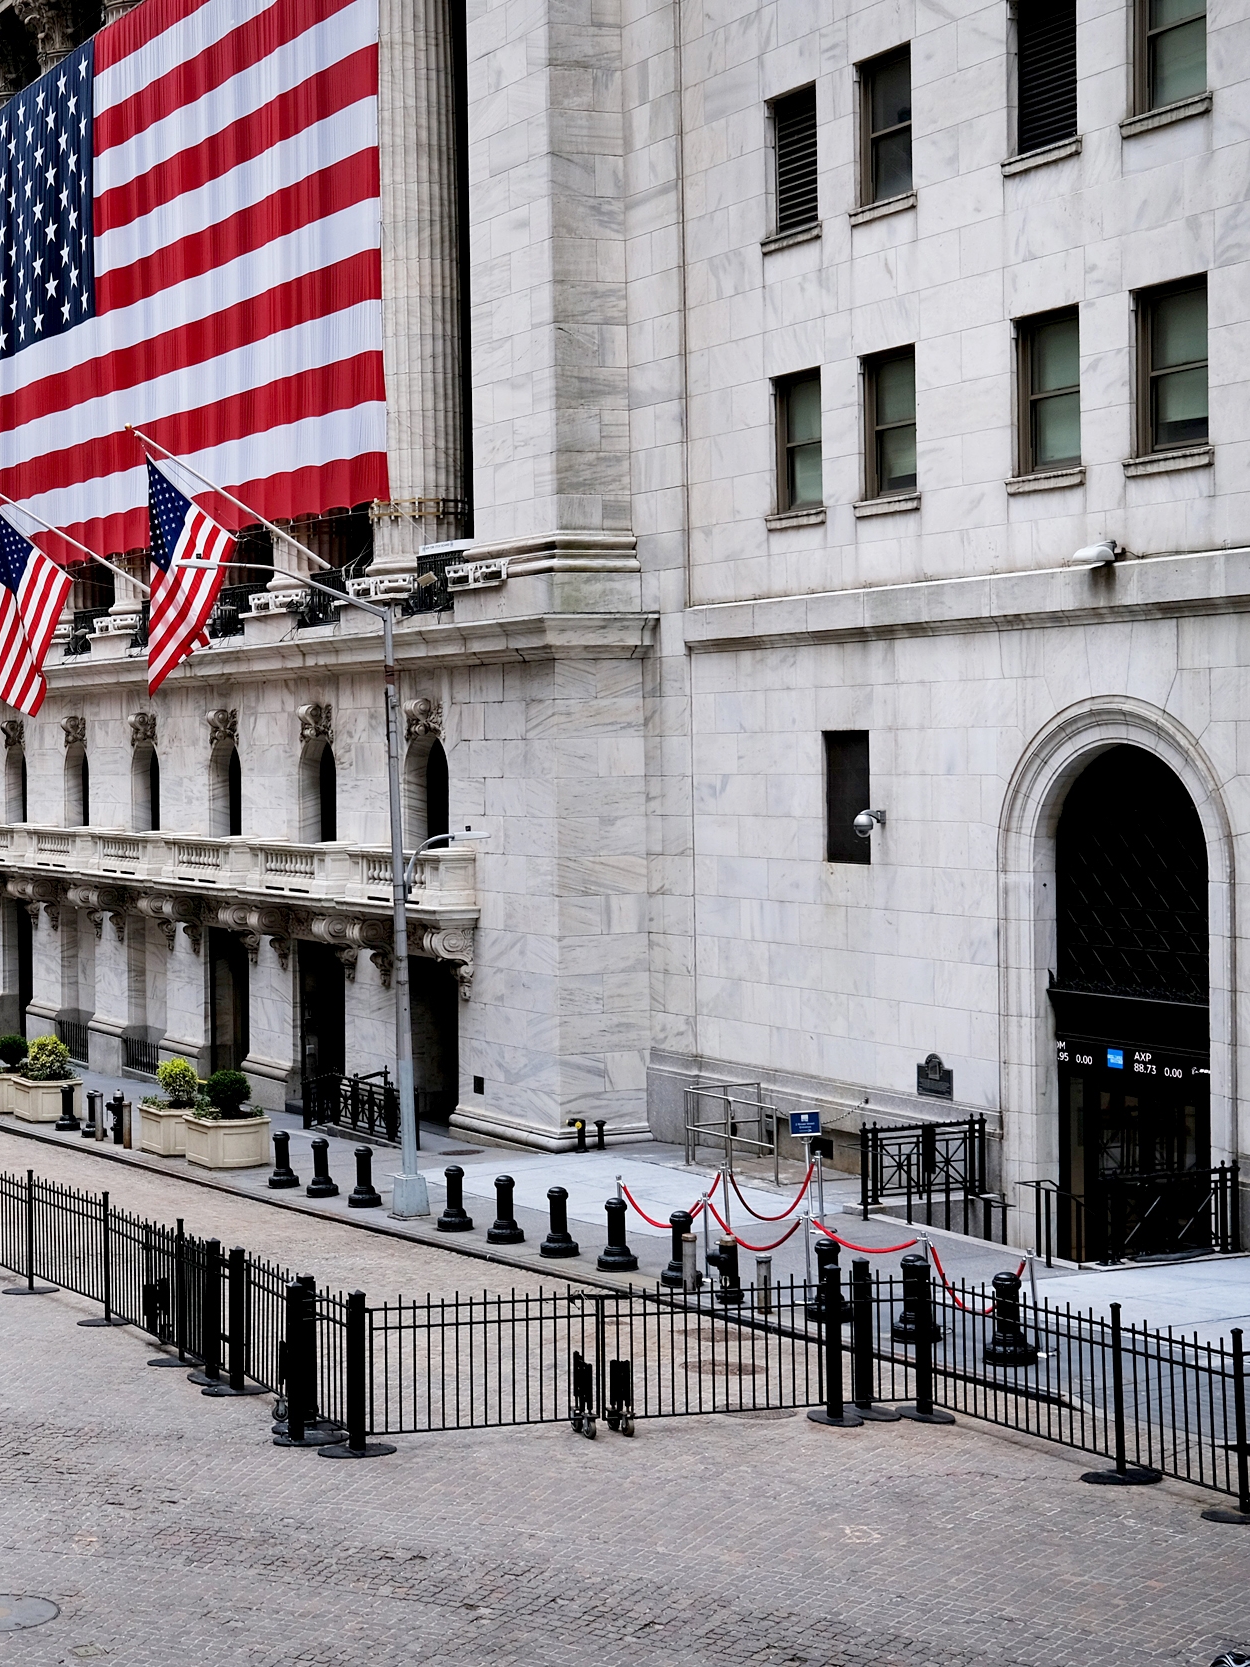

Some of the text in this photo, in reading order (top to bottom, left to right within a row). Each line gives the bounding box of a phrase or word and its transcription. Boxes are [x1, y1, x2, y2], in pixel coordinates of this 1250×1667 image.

[1075, 1053, 1093, 1066] 0.00
[1133, 1051, 1152, 1063] AXP
[1133, 1062, 1157, 1075] 88.73
[1164, 1066, 1183, 1079] 0.00
